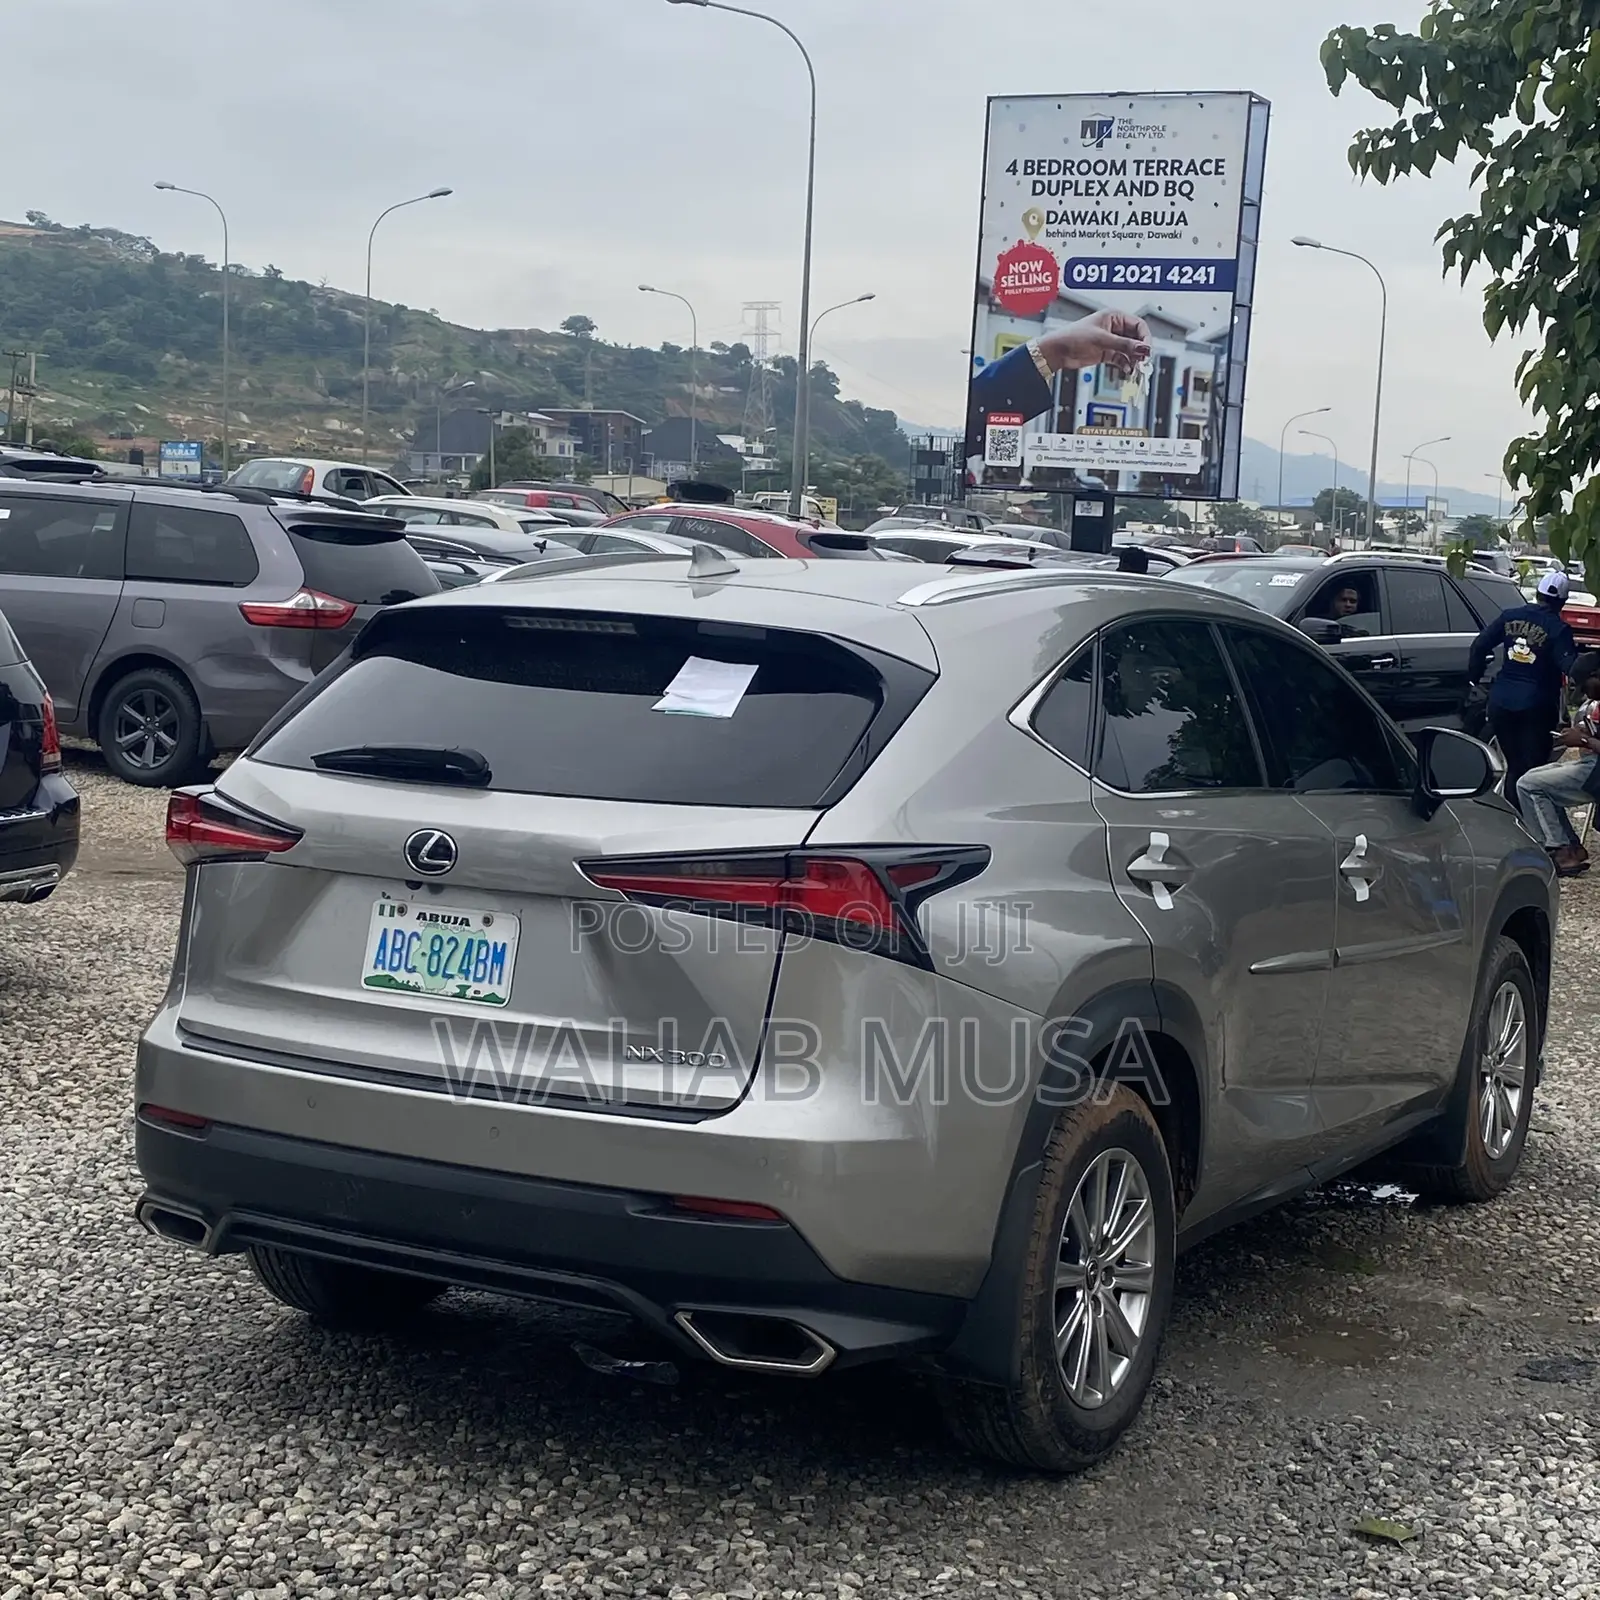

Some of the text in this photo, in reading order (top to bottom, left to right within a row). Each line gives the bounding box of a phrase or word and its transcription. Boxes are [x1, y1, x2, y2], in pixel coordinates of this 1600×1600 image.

[1116, 124, 1167, 132] NORTHPOLE
[1005, 158, 1225, 176] 4 BEDROOM TERRACE
[1031, 180, 1195, 201] DUPLEX AND BQ
[1045, 210, 1119, 226] DAWAKI
[1045, 229, 1183, 241] behind Market Square, Dawaki
[1008, 260, 1043, 274] NOW
[1072, 264, 1216, 285] 091 2021 4241
[1000, 271, 1053, 288] SELLING
[989, 415, 1009, 423] SCAN
[1082, 427, 1144, 437] ESTATE FEATURES
[416, 911, 471, 927] ABUJA
[373, 927, 508, 986] ABC-824BM
[625, 1044, 726, 1067] NX 300
